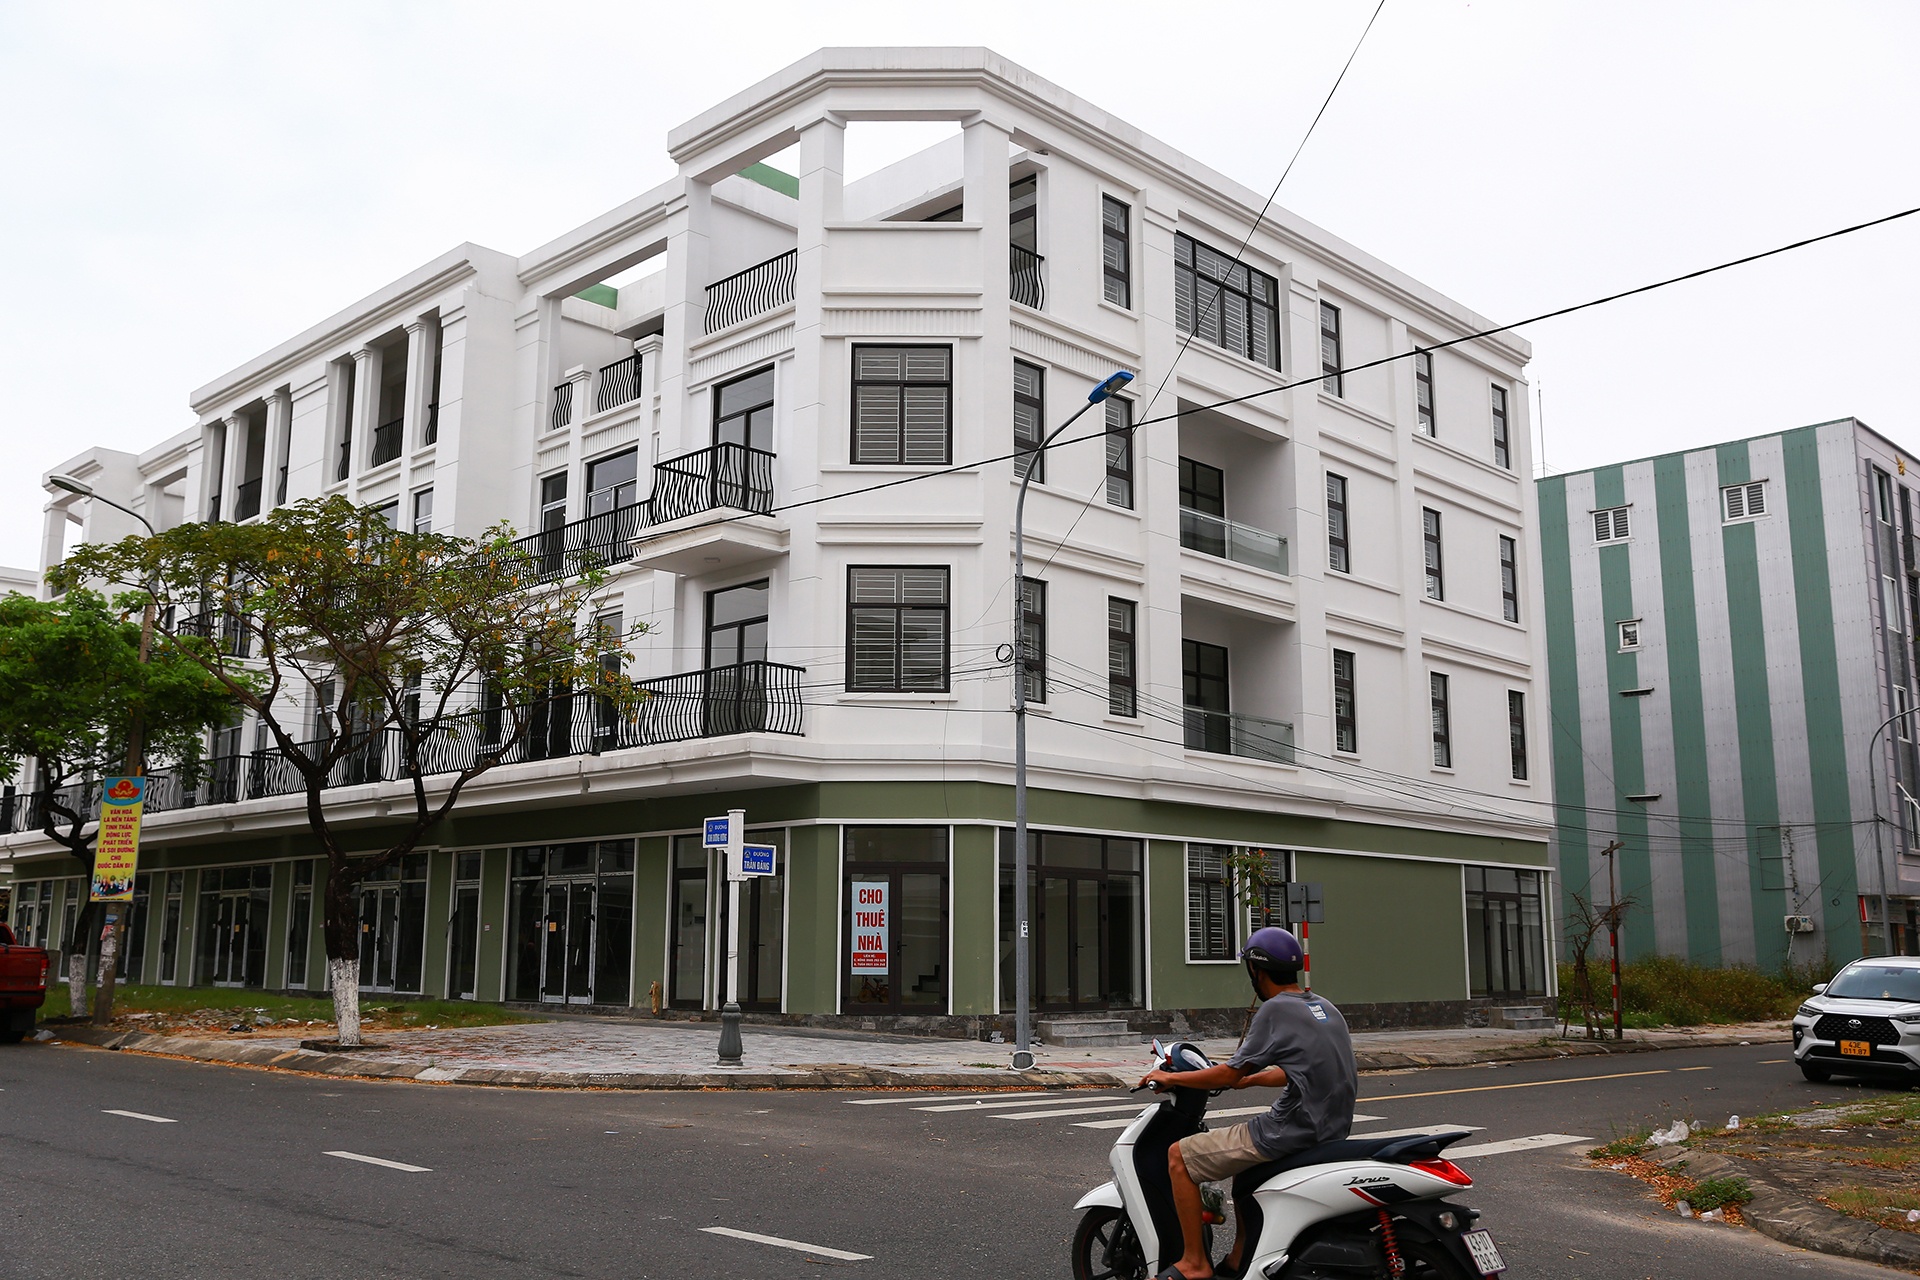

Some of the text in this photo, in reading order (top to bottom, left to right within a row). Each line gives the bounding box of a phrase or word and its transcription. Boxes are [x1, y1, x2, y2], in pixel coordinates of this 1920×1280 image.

[753, 850, 770, 858] ĐƯỜNG
[859, 888, 883, 905] CHO
[856, 908, 885, 927] THUÊ
[858, 932, 883, 951] NHÀ
